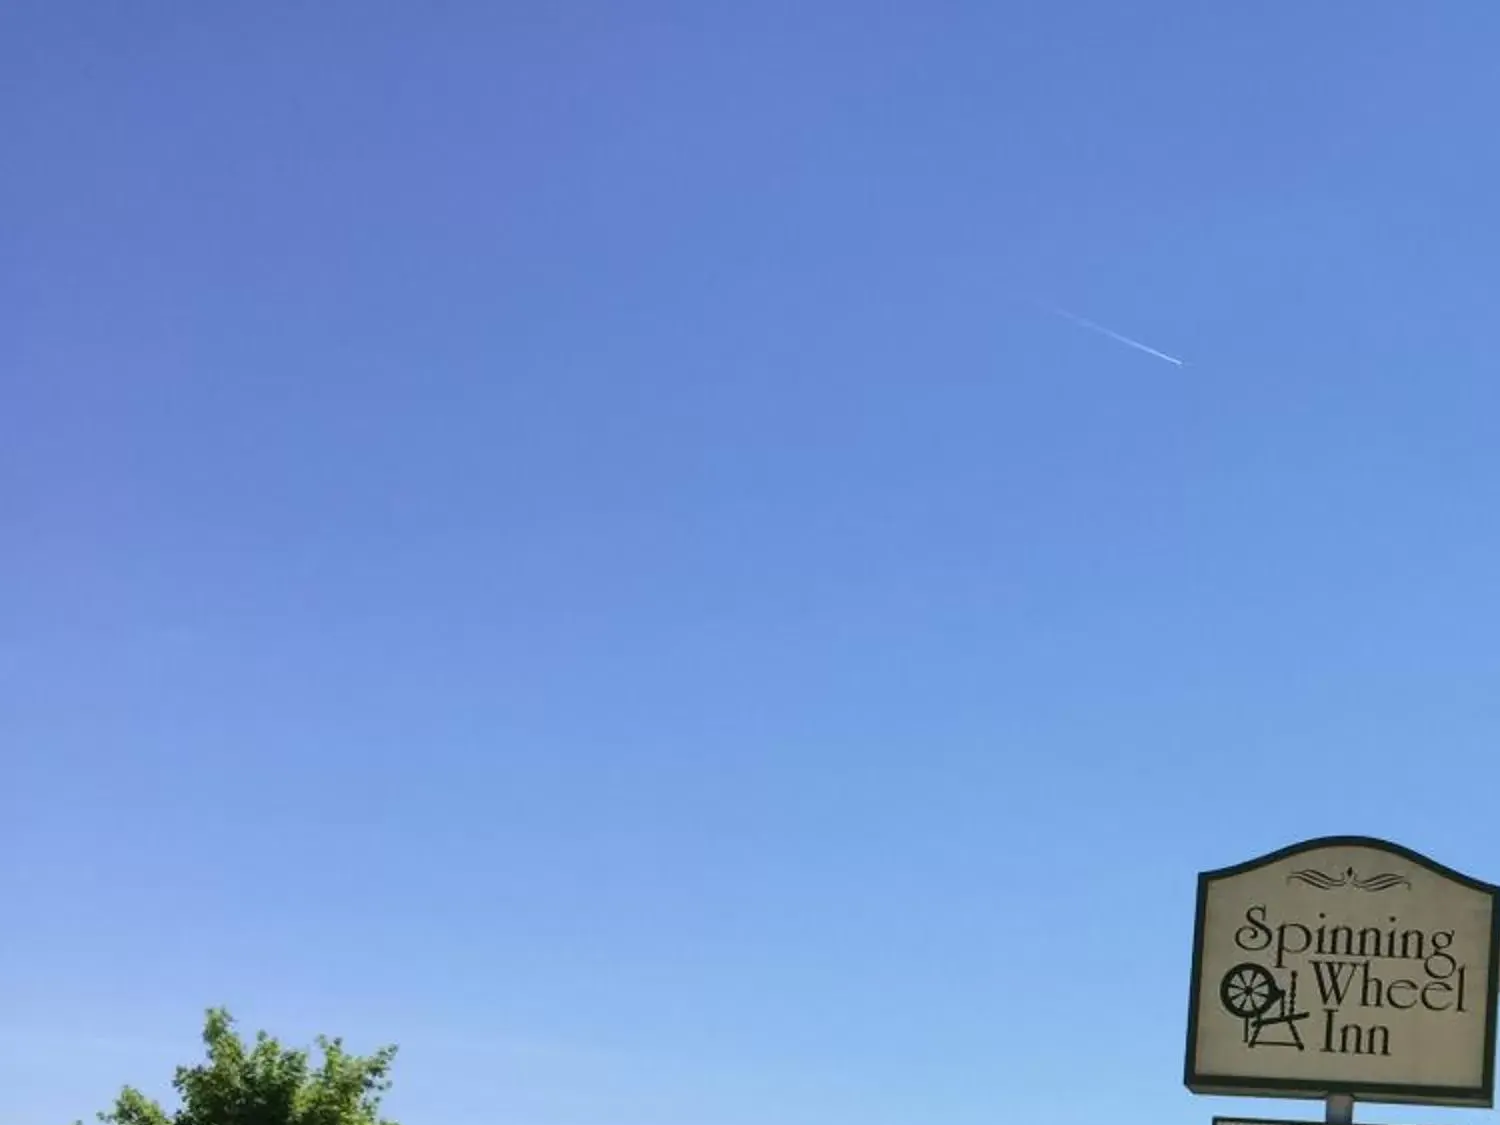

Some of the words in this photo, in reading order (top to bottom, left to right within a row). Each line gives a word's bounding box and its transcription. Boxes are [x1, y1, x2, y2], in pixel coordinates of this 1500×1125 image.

[1234, 903, 1456, 980] Spinning
[1308, 959, 1470, 1013] Wheel
[1319, 1009, 1391, 1057] Inn
